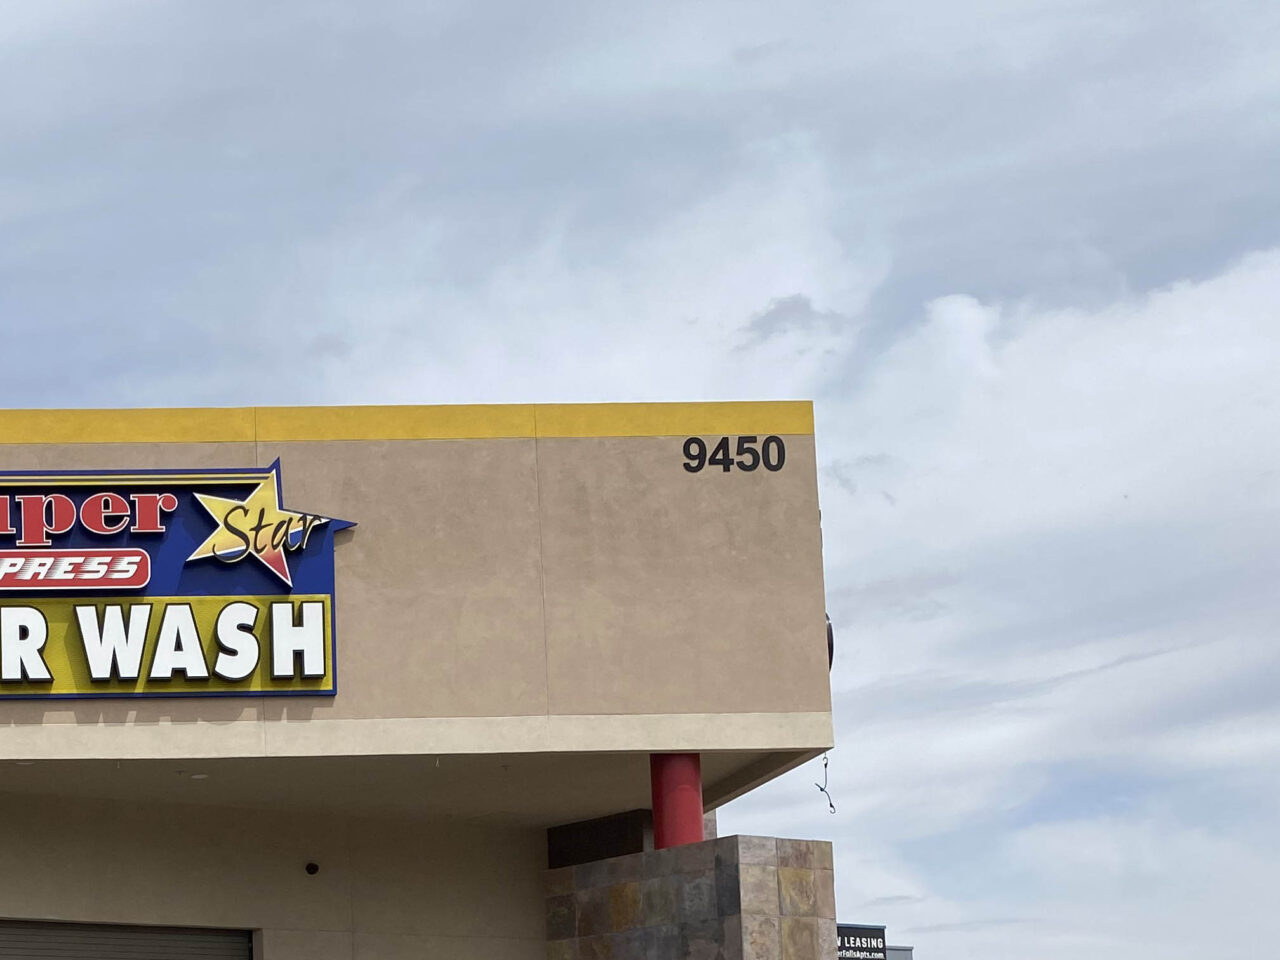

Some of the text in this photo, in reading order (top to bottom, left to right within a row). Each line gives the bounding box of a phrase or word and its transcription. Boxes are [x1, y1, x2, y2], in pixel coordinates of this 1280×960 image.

[682, 435, 786, 473] 9450
[211, 504, 322, 563] Star
[73, 600, 326, 683] WASH
[844, 936, 884, 949] LEASING
